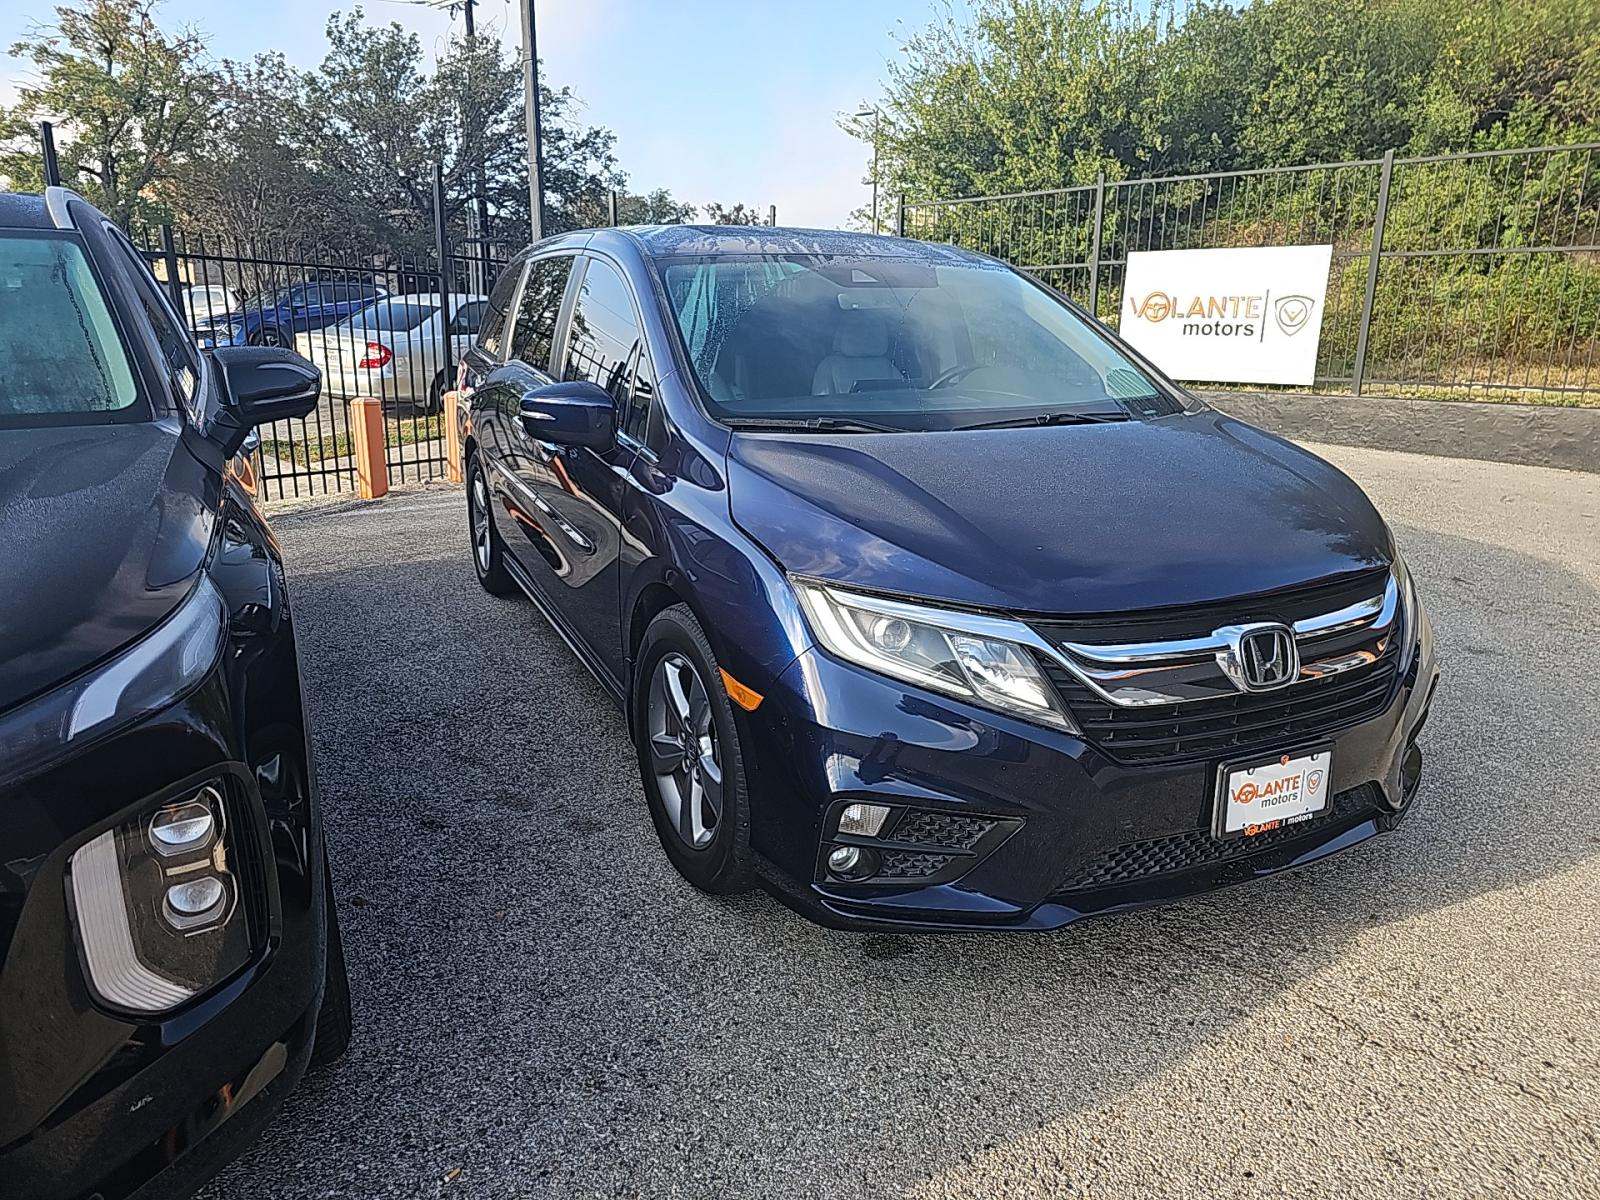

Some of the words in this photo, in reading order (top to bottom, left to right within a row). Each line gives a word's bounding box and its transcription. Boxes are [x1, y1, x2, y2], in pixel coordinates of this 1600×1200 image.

[1130, 291, 1262, 323] VOLANTE
[1183, 321, 1254, 336] motors
[1231, 775, 1300, 803] VOLANTE
[1261, 792, 1298, 808] motors
[1244, 820, 1280, 836] VOLANTE
[1287, 814, 1313, 825] motors
